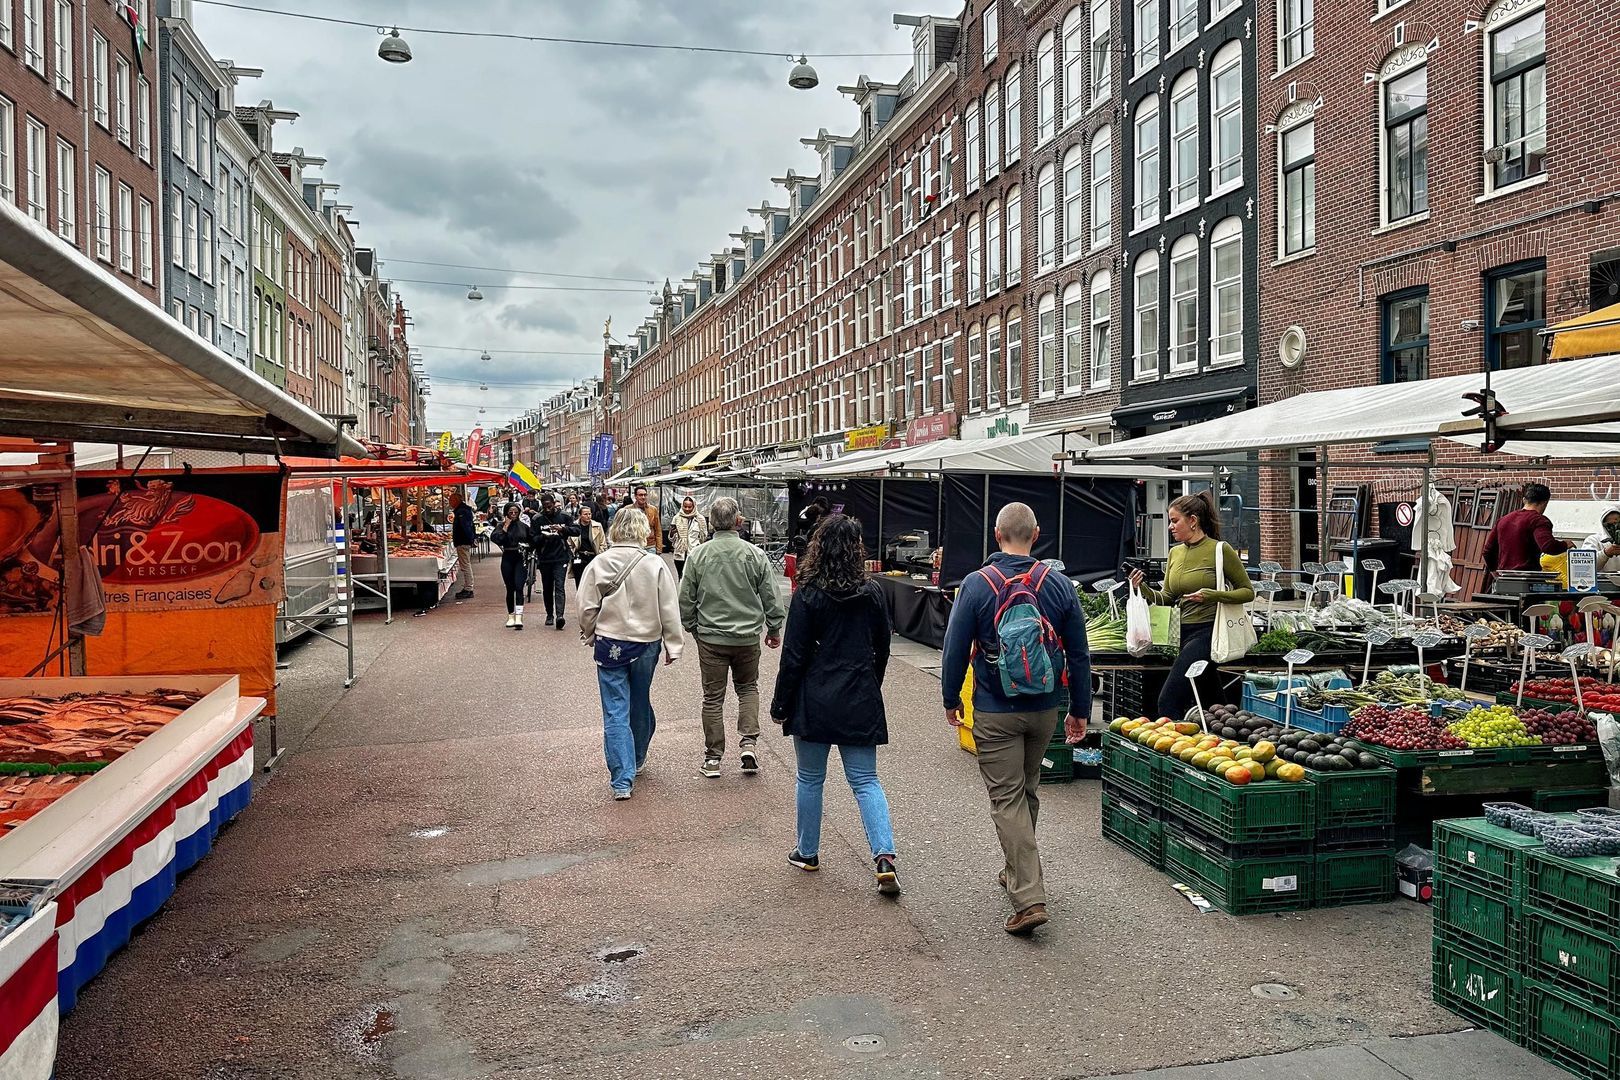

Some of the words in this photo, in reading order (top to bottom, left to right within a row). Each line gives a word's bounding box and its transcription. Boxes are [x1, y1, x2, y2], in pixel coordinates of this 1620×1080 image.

[125, 531, 158, 566] &
[159, 530, 242, 564] Zoon
[134, 587, 212, 603] Françaises
